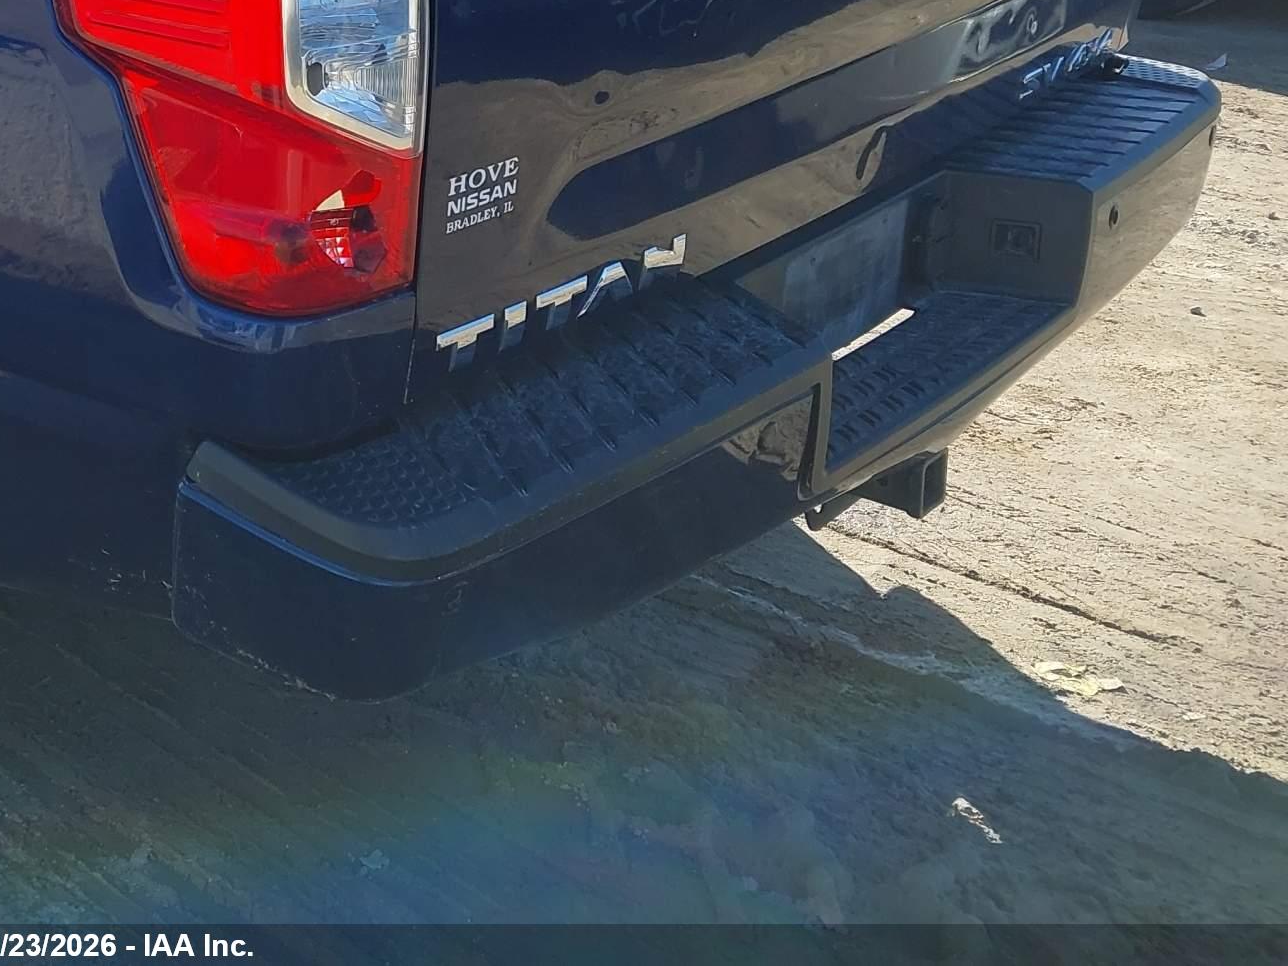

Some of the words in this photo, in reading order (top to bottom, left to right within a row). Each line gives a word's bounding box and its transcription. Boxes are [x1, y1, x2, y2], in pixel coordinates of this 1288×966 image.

[448, 156, 520, 198] HOVE
[446, 206, 502, 234] BRADLEY,
[504, 200, 515, 213] IL
[447, 179, 518, 217] NISSAN
[436, 233, 687, 372] TITAN
